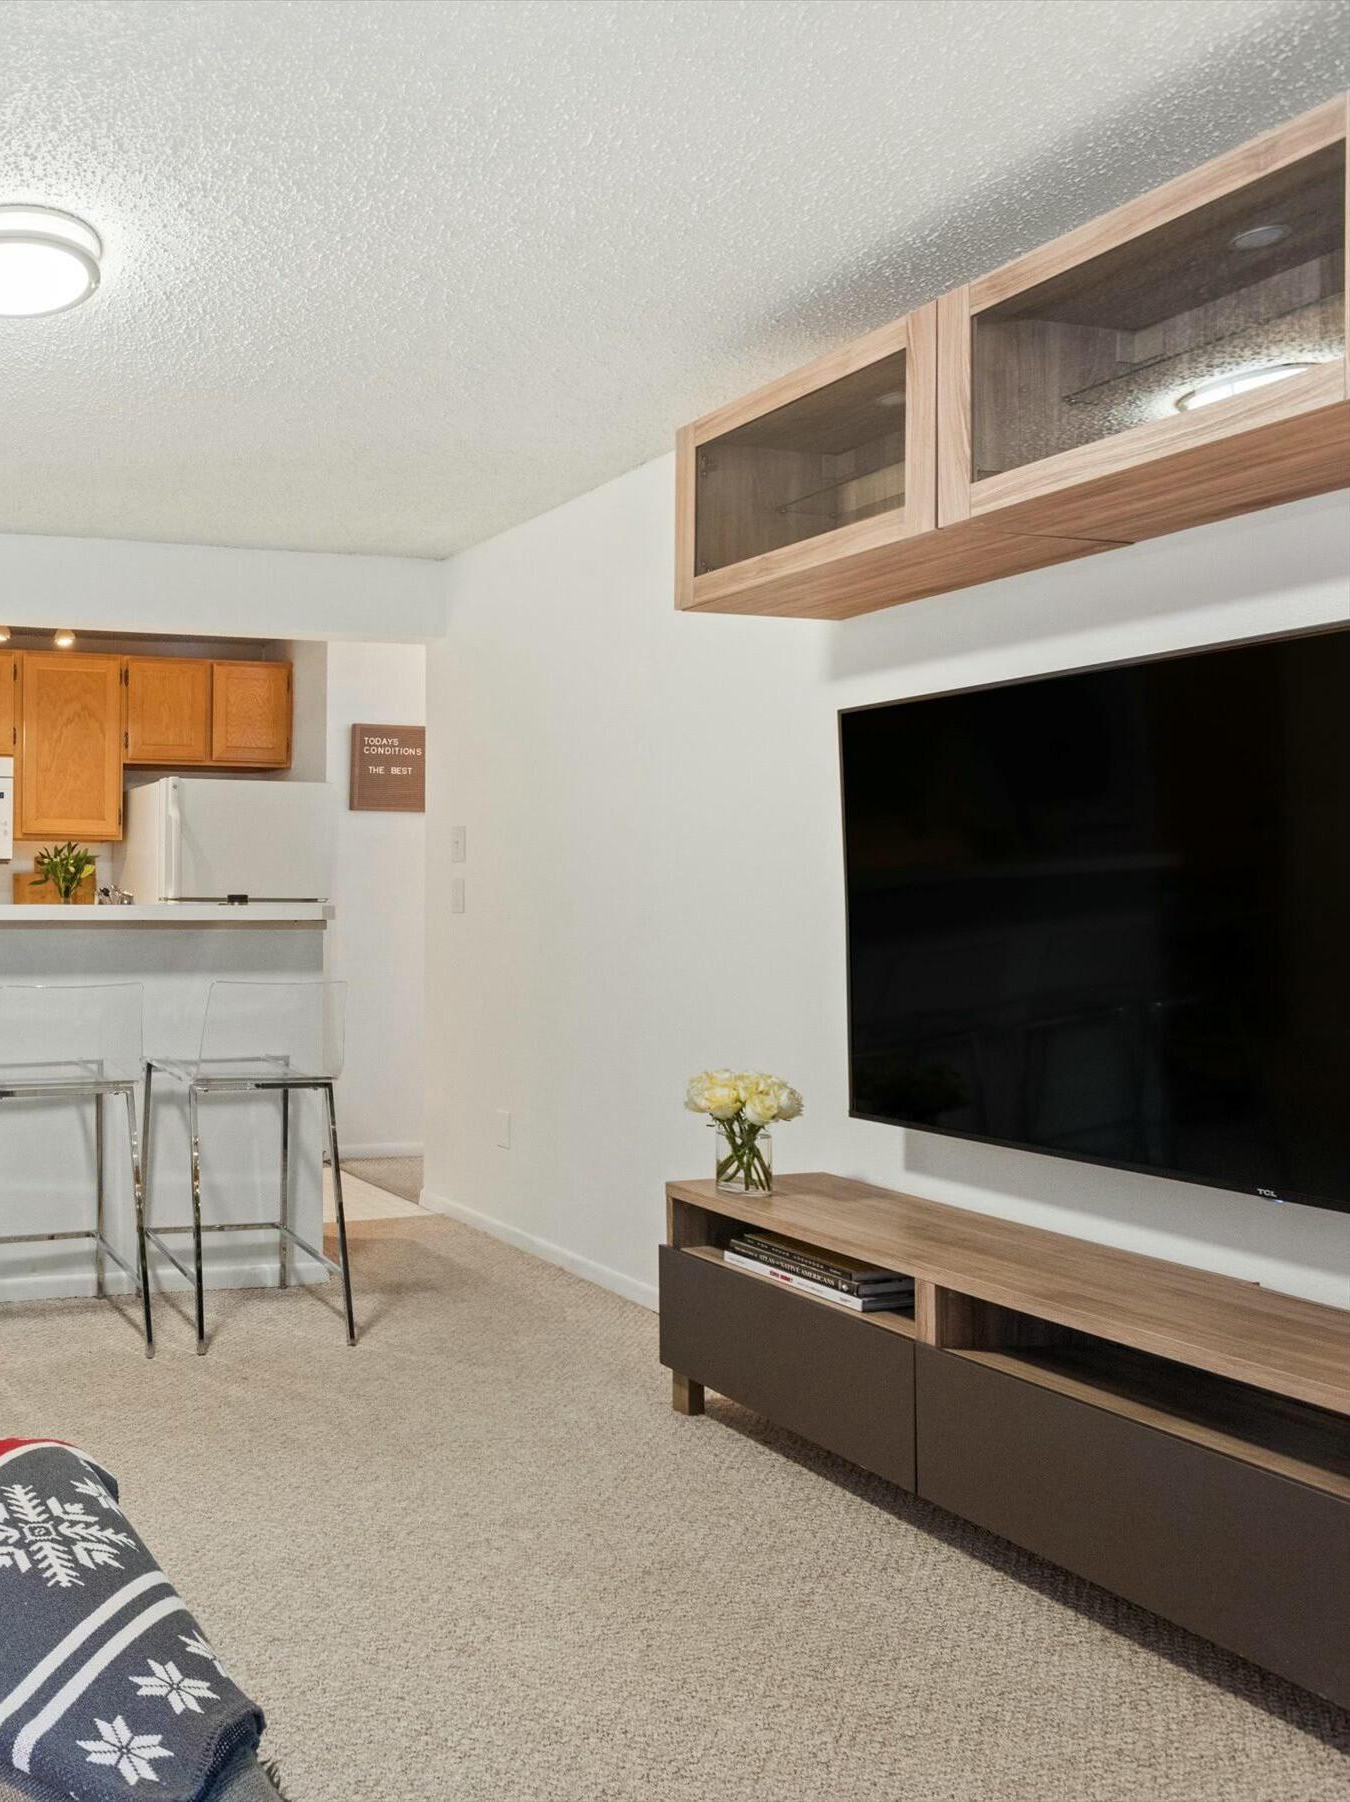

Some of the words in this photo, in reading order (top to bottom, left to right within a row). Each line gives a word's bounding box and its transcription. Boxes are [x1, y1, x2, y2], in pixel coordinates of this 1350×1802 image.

[363, 737, 399, 746] TODAYS
[363, 746, 422, 756] CONDITIONS
[368, 766, 385, 774] THE
[390, 766, 413, 775] BEST
[1257, 1188, 1277, 1198] TCL
[801, 1268, 835, 1287] AMERICANS
